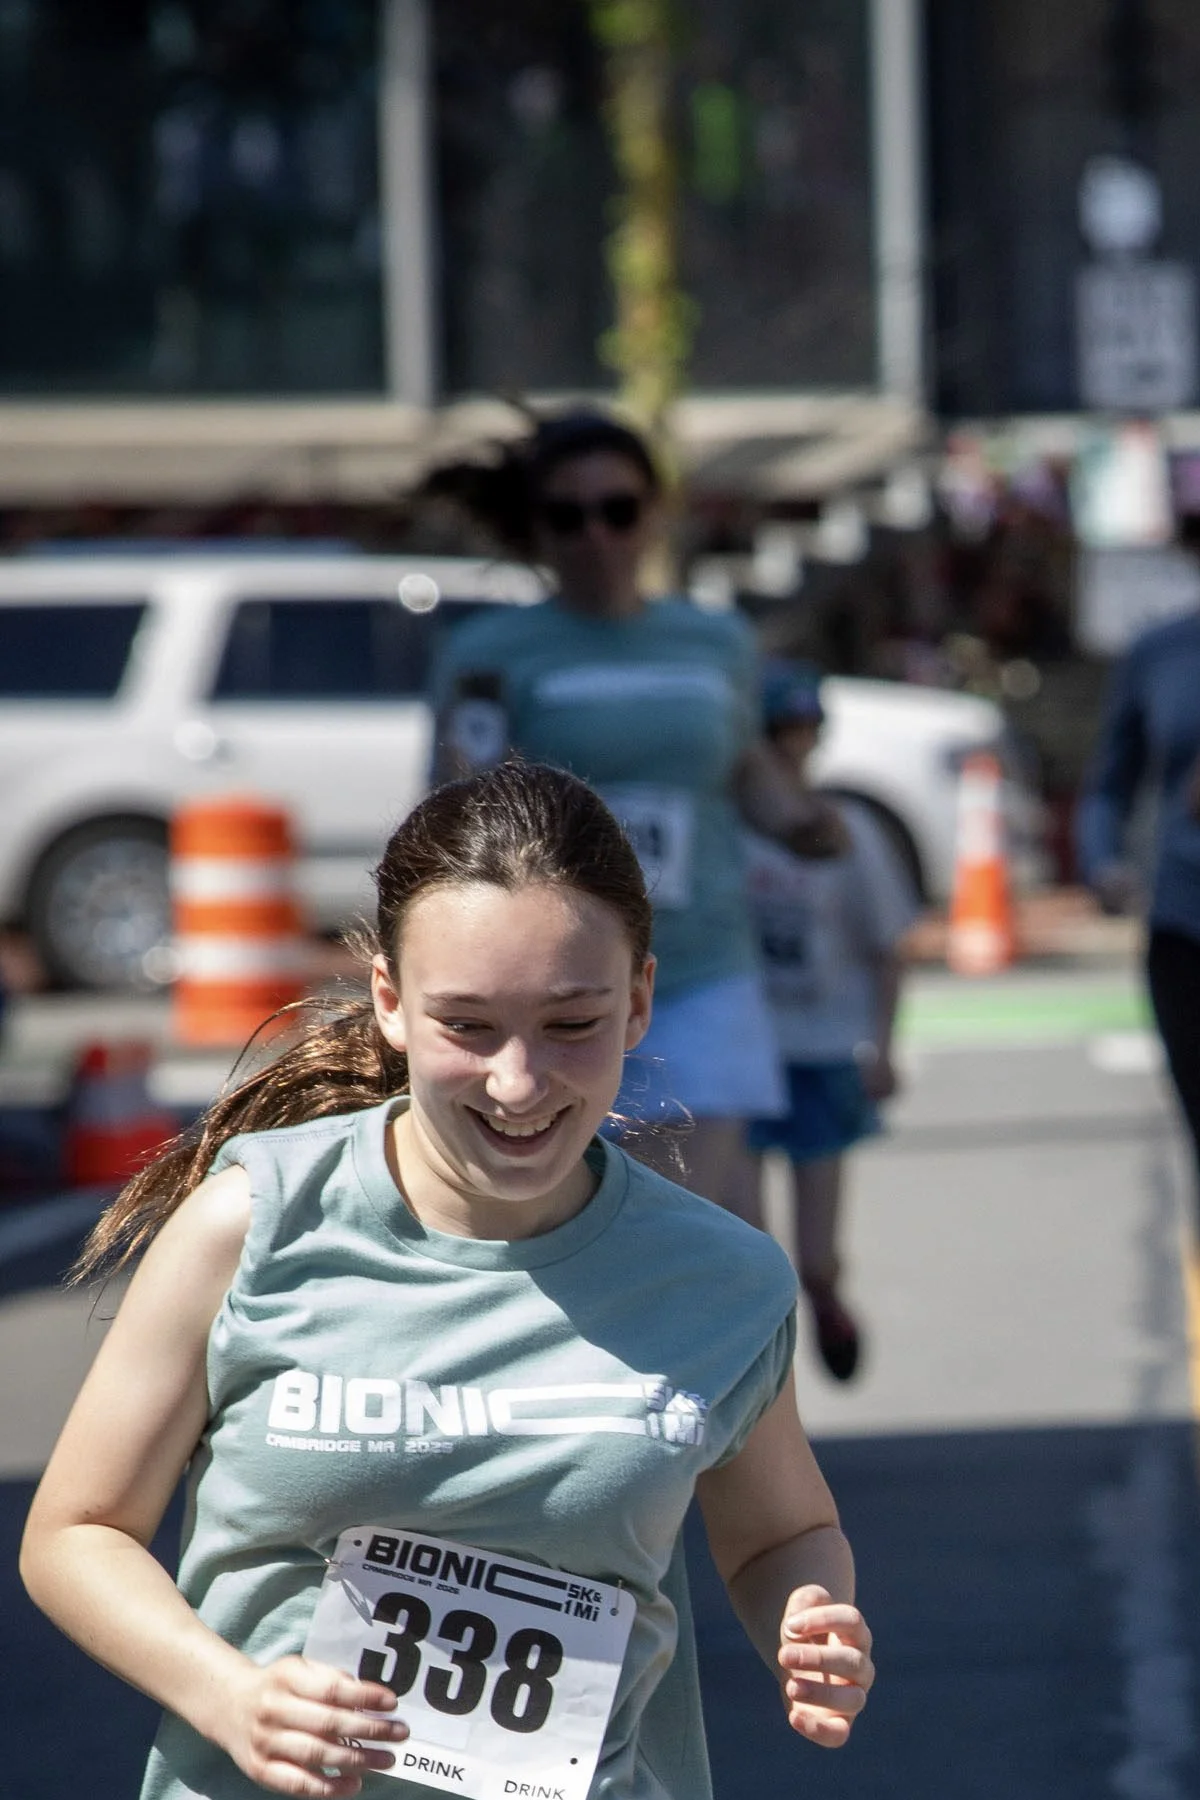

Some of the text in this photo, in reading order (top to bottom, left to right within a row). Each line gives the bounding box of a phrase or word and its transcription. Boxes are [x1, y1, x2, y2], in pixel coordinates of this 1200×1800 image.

[267, 1370, 649, 1436] BIONIC
[265, 1432, 361, 1453] CAMBRIDGE
[367, 1440, 396, 1453] MA
[365, 1534, 569, 1612] BIONIC
[358, 1591, 564, 1734] 338
[403, 1753, 566, 1800] DRINK DRINK
